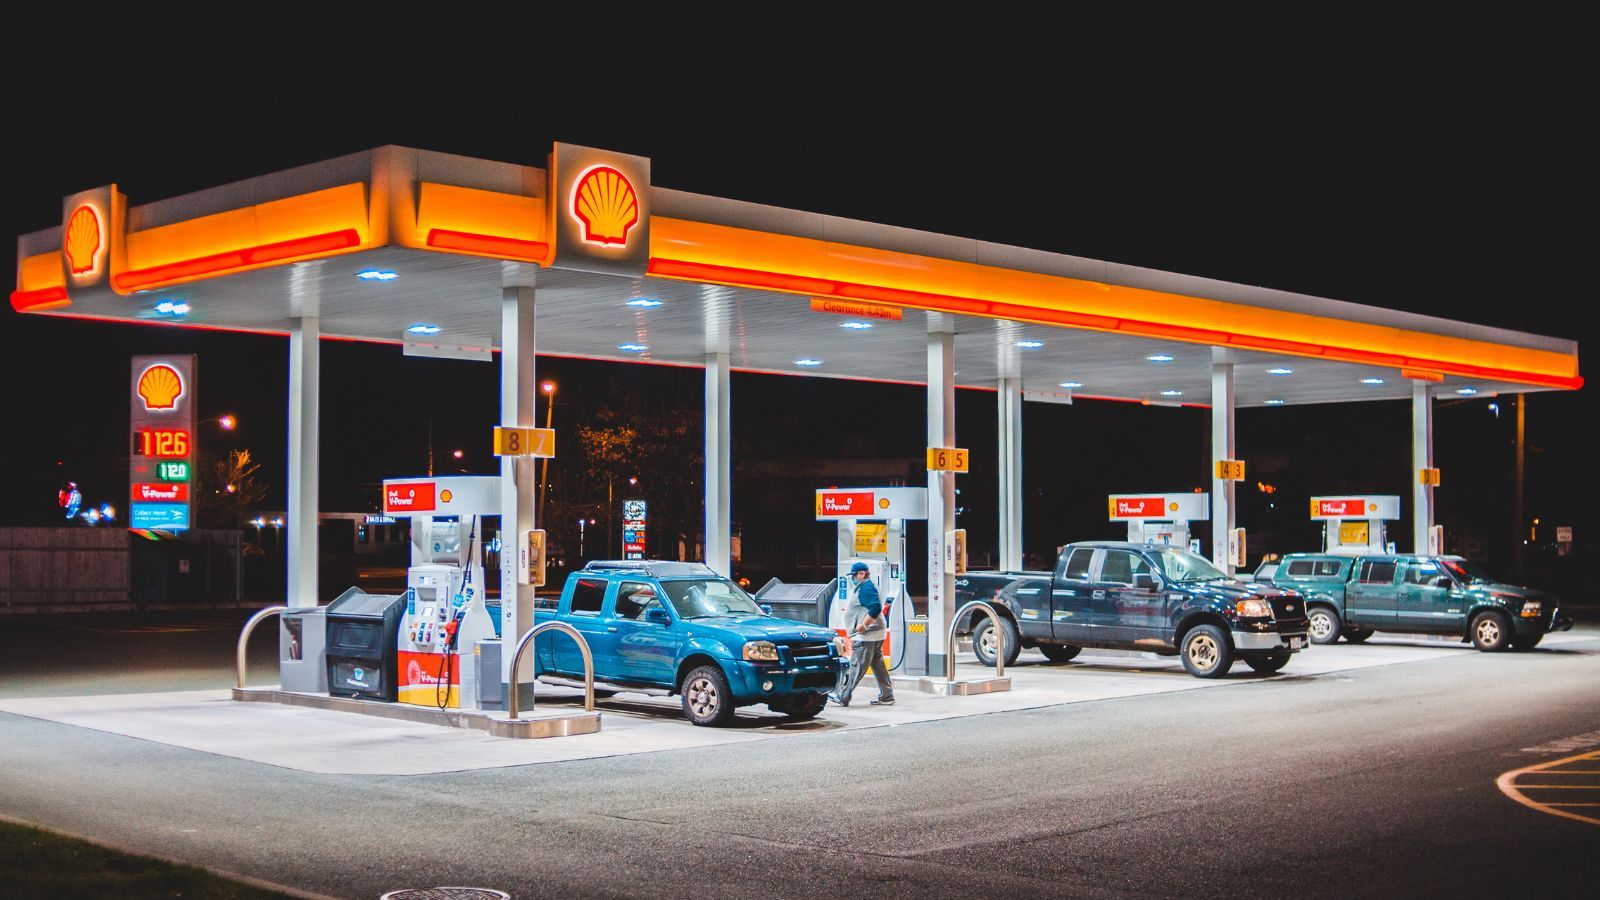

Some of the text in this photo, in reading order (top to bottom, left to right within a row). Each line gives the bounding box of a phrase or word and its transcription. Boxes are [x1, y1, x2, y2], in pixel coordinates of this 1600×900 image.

[823, 301, 864, 315] Clearance
[509, 432, 547, 453] 8 7
[938, 451, 963, 468] 6 5
[1223, 463, 1241, 477] 4 3
[142, 490, 177, 499] V-Power
[389, 497, 413, 505] V-Power
[825, 503, 851, 511] V-Power
[421, 674, 448, 684] V-Power
